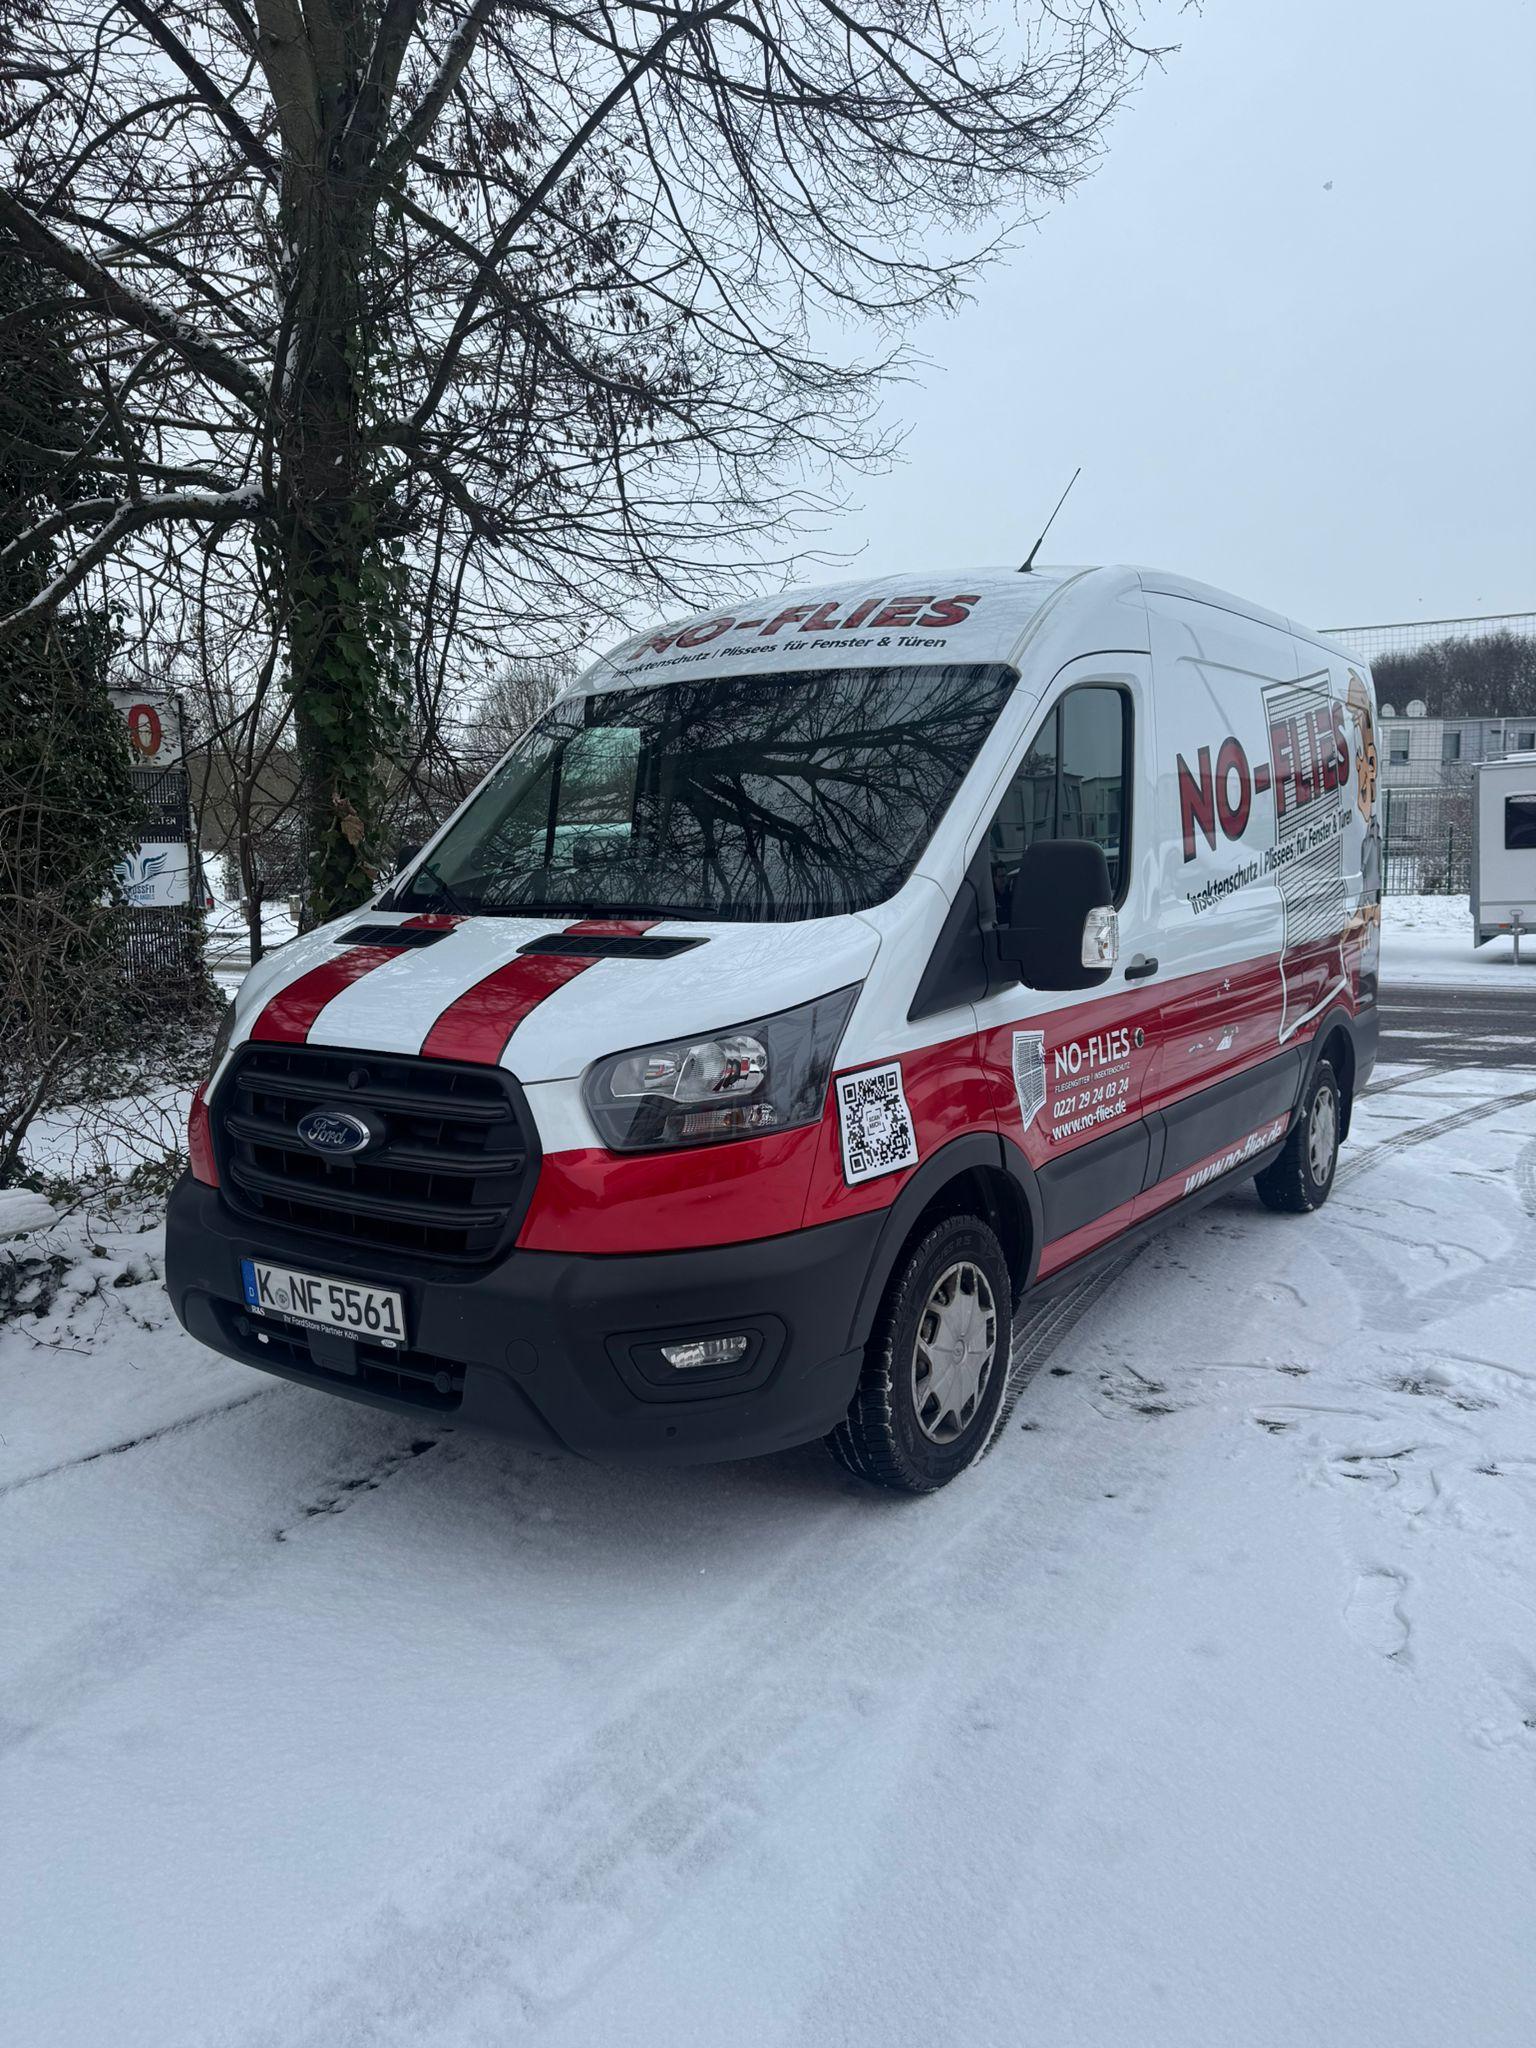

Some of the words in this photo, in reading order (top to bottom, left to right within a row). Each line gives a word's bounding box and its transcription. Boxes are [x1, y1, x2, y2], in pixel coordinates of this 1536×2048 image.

[626, 594, 982, 662] NO-FLIES
[611, 652, 710, 679] Insektenschutz
[719, 643, 778, 658] Plissees
[783, 640, 808, 651] für
[811, 637, 874, 649] Fenster
[877, 636, 891, 647] &
[898, 637, 947, 648] Türen
[1176, 701, 1350, 864] NO-FLIES
[1187, 859, 1258, 915] Insektenschutz
[1264, 846, 1295, 875] Plissees
[1295, 831, 1308, 854] für
[1309, 820, 1331, 847] Fenster
[1332, 814, 1338, 834] &
[1054, 1028, 1131, 1079] NO-FLIES
[1094, 1061, 1131, 1080] INSEKTENSCHUTZ
[1052, 1098, 1127, 1140] www.no-flies.de
[1053, 1096, 1076, 1119] 0221
[1078, 1091, 1090, 1110] 29
[1092, 1087, 1104, 1105] 24
[1105, 1081, 1117, 1099] 03
[1118, 1077, 1129, 1095] 24
[307, 1118, 346, 1145] Ford
[257, 1267, 275, 1305] K
[282, 1314, 291, 1323] Ihr
[291, 1317, 321, 1332] FordStore
[320, 1325, 344, 1337] Partner
[344, 1329, 359, 1341] Köln
